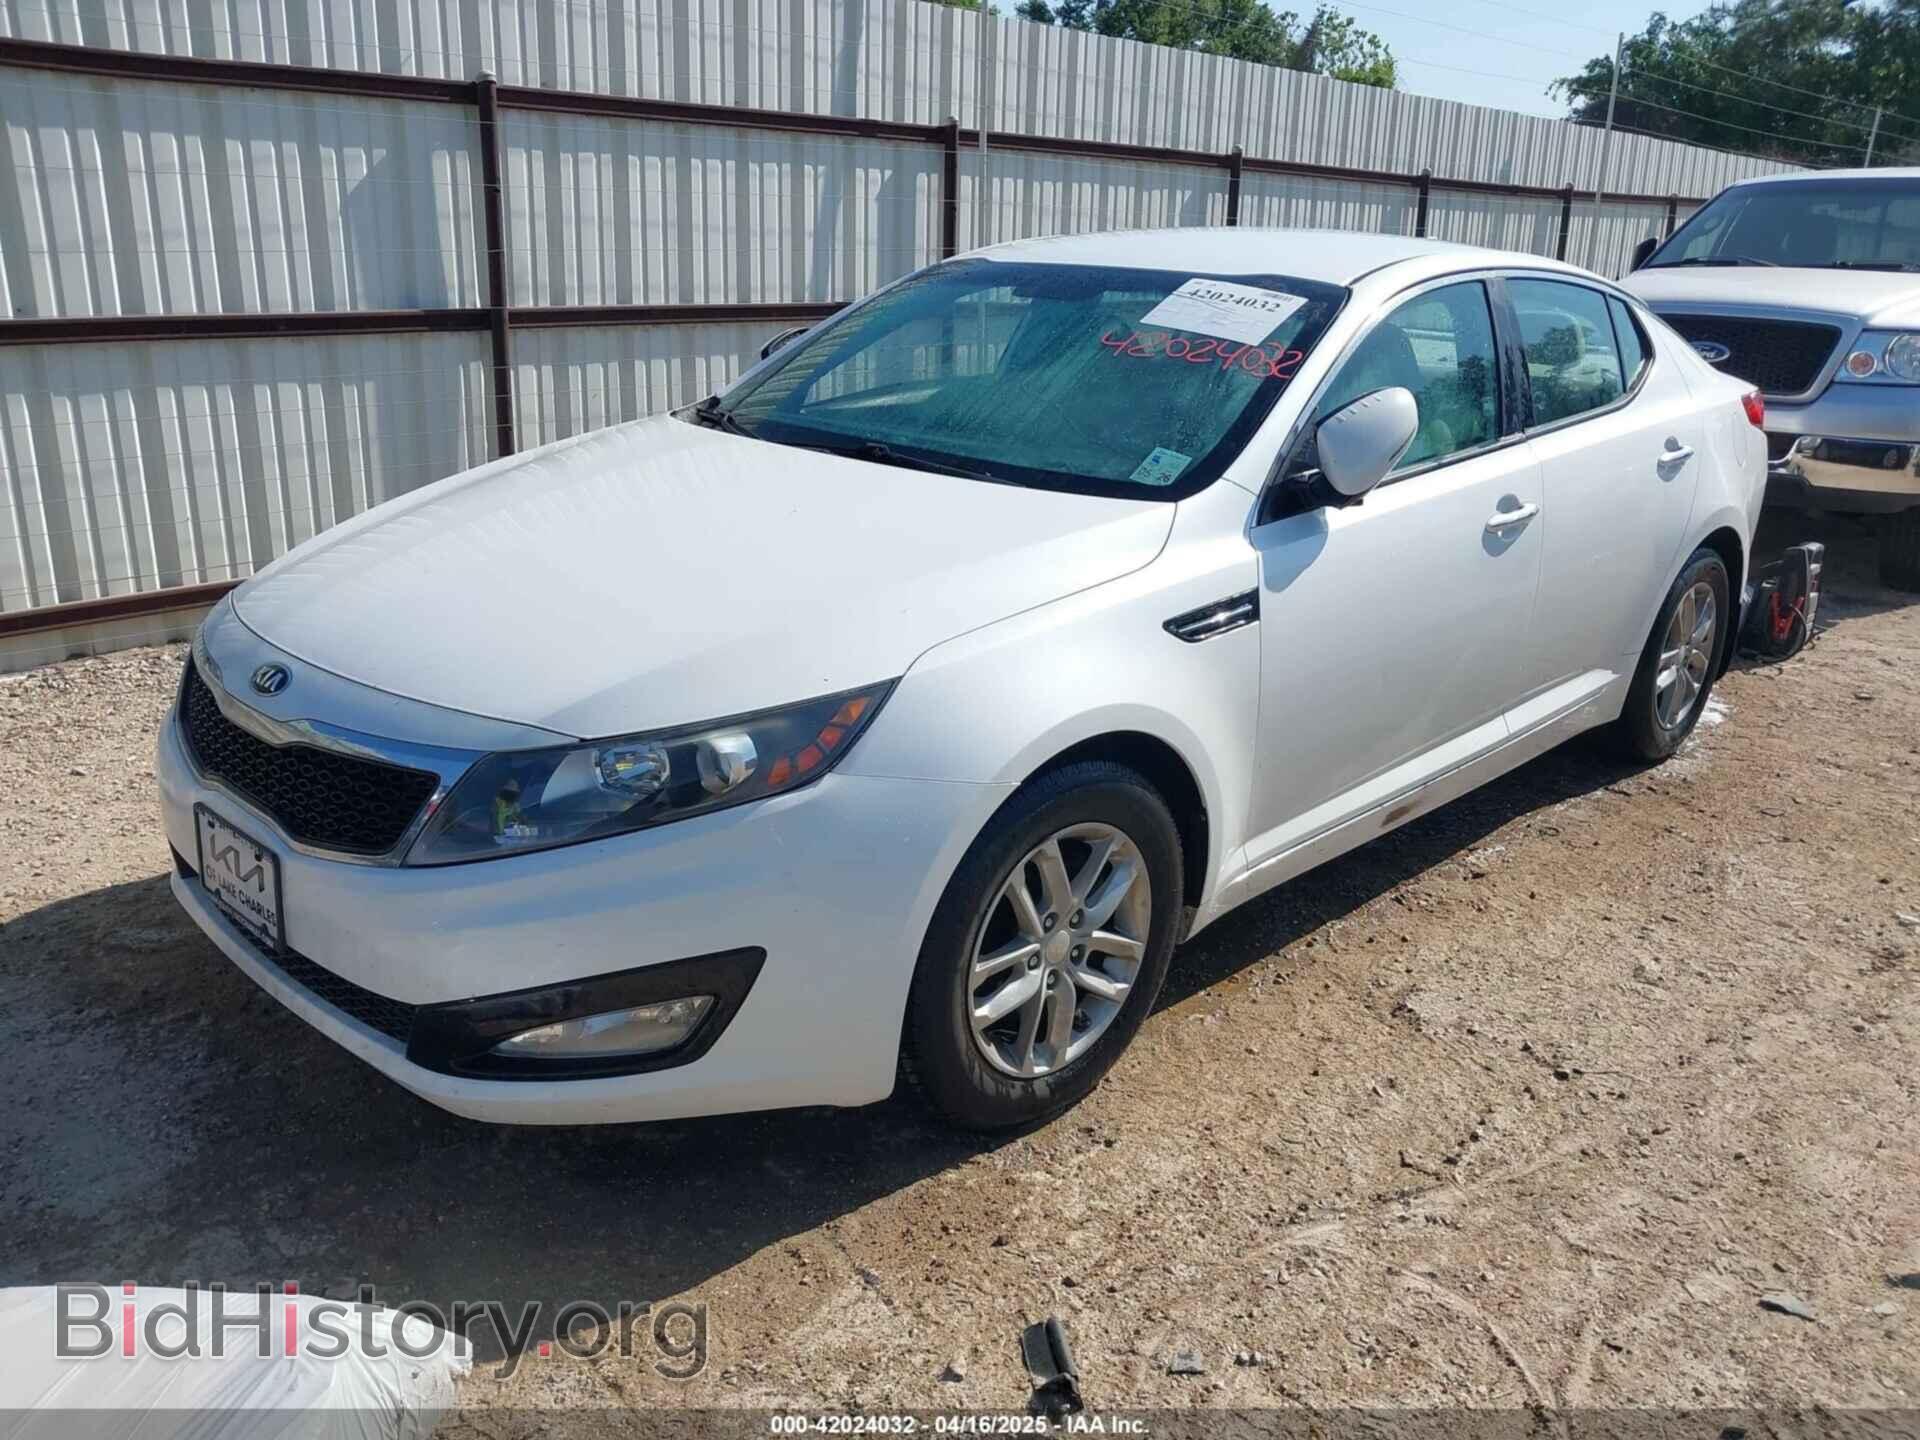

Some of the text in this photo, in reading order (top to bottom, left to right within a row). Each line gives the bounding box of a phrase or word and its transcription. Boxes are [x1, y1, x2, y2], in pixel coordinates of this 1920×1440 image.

[1187, 288, 1282, 313] 42024032
[218, 873, 238, 899] LAKE
[239, 888, 277, 927] CHARLES
